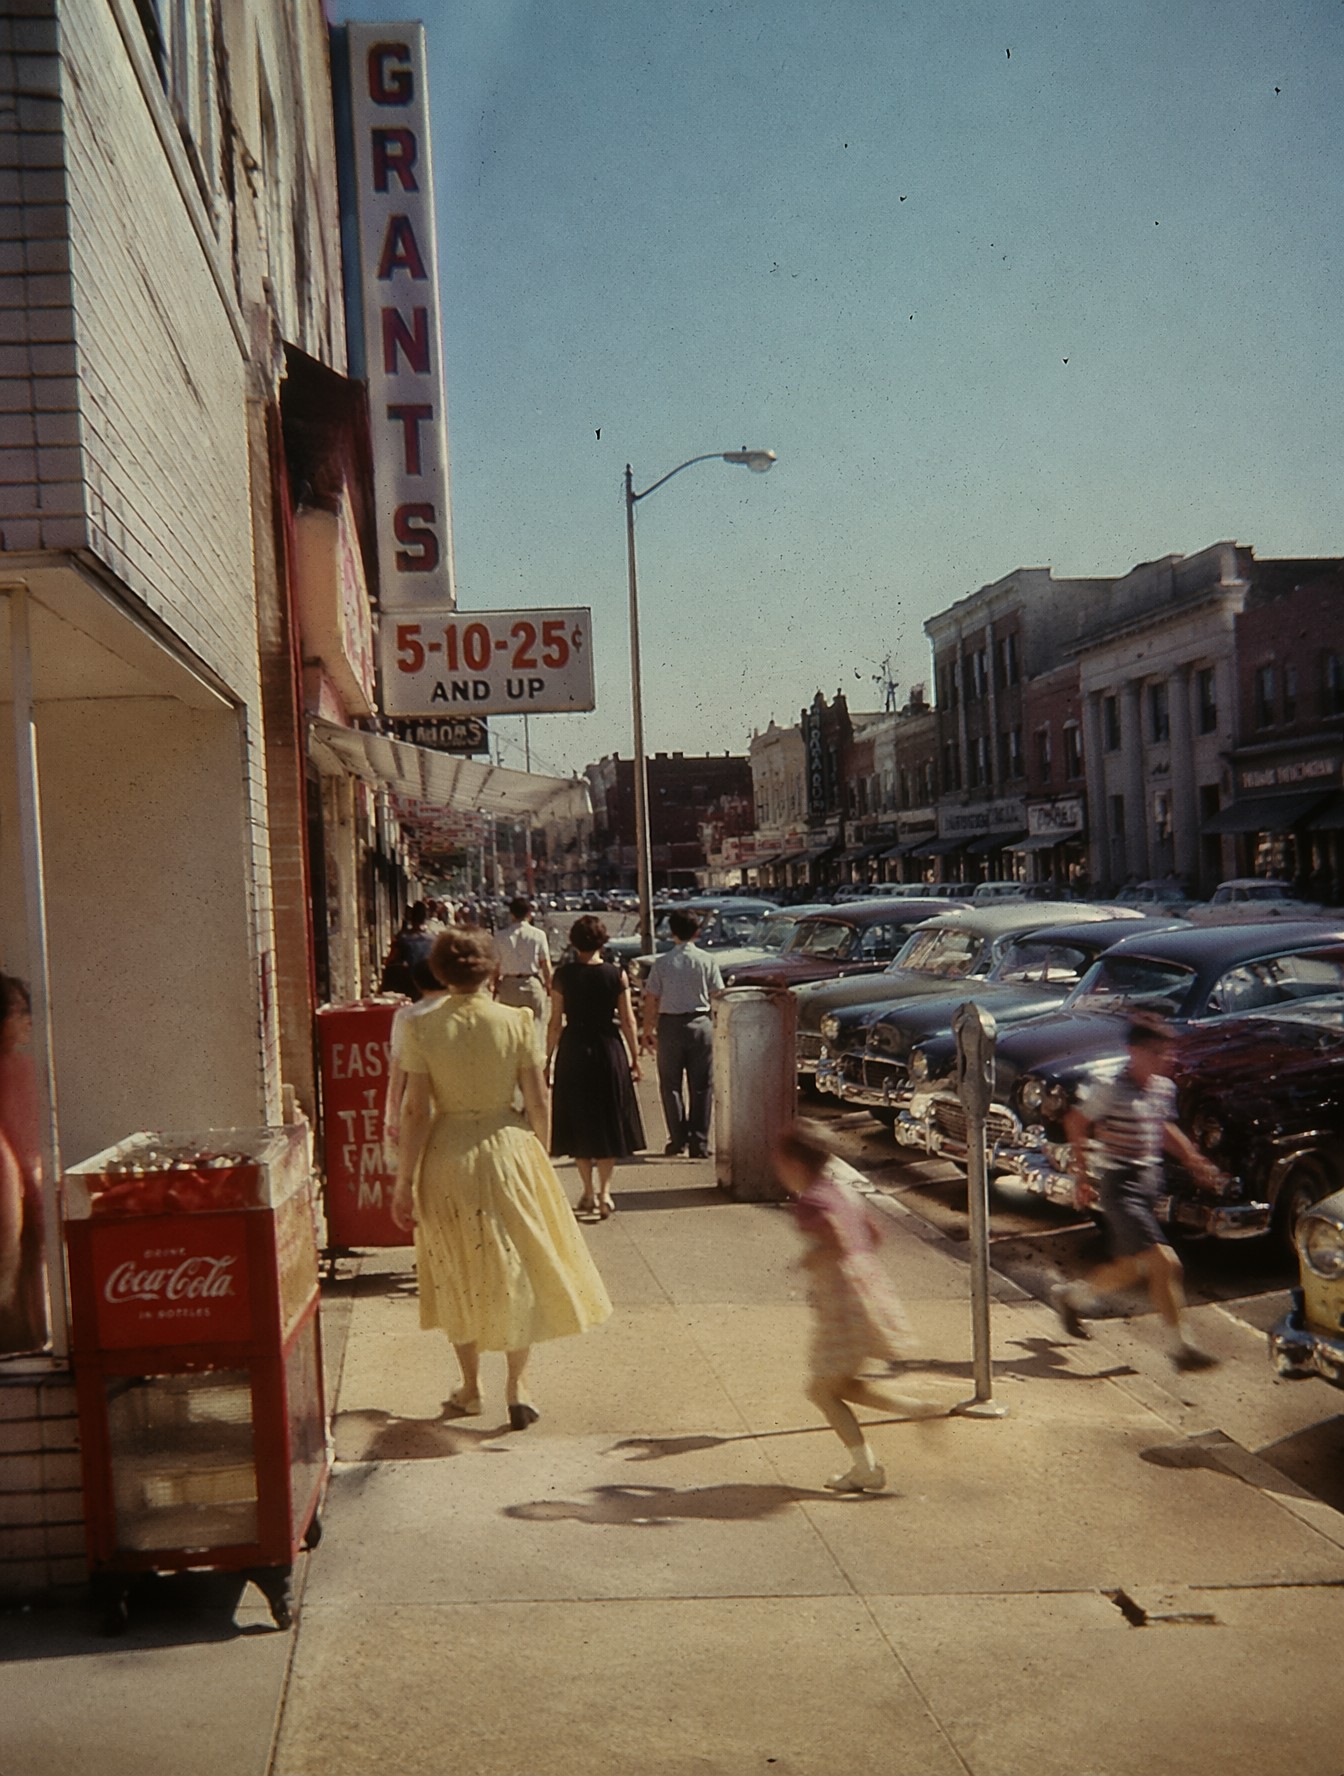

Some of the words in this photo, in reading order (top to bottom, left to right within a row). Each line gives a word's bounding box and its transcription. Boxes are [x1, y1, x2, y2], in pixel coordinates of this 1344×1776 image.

[368, 41, 440, 573] GRANTS
[396, 620, 583, 673] 5-10-25¢
[430, 680, 491, 703] AND
[506, 677, 545, 700] UP
